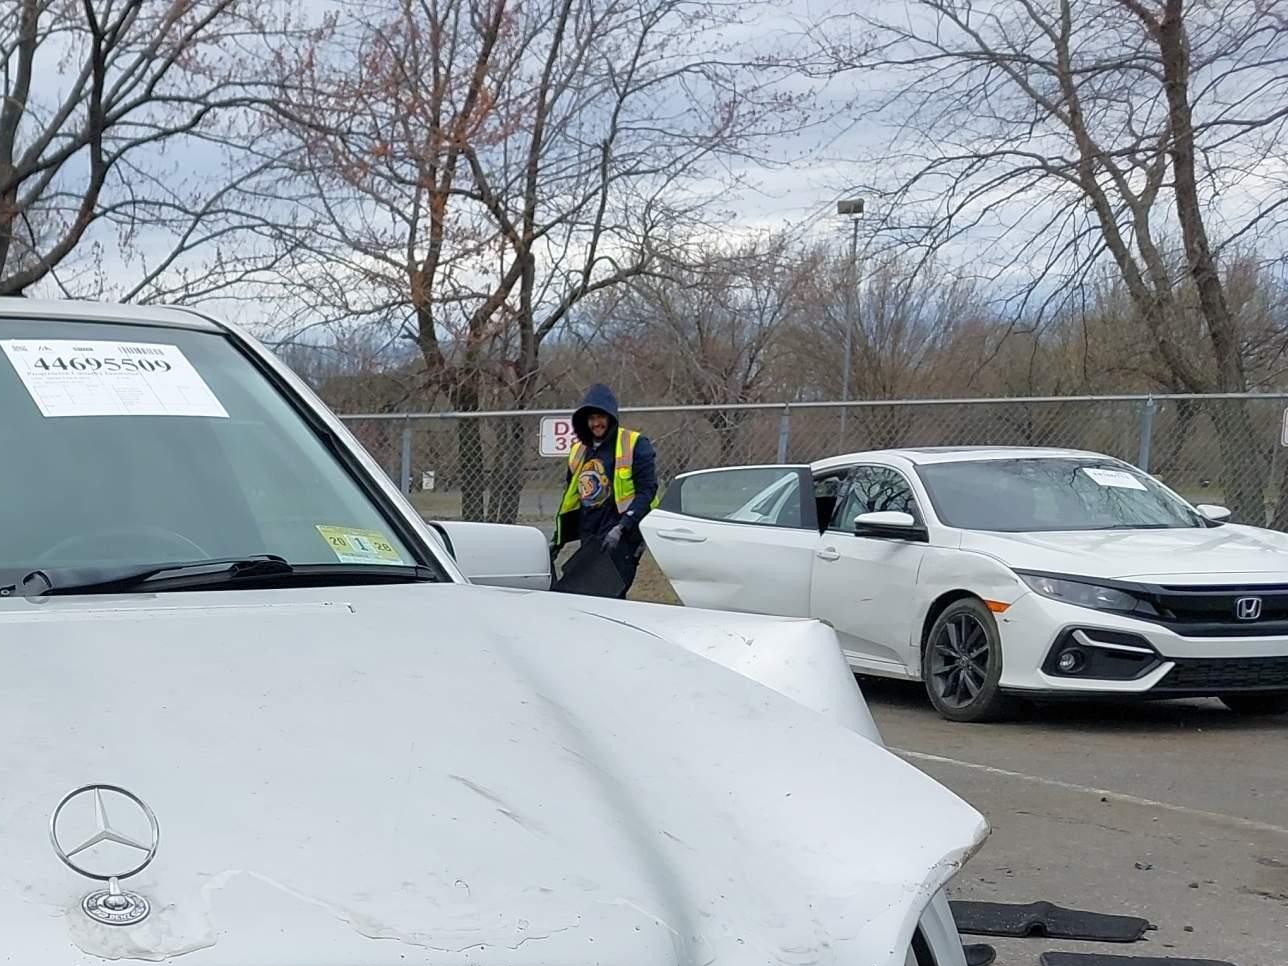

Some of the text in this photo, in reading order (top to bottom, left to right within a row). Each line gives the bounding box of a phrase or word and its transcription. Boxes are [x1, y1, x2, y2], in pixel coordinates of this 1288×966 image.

[34, 356, 171, 373] 44695509
[554, 421, 575, 436] D
[354, 537, 368, 551] 1
